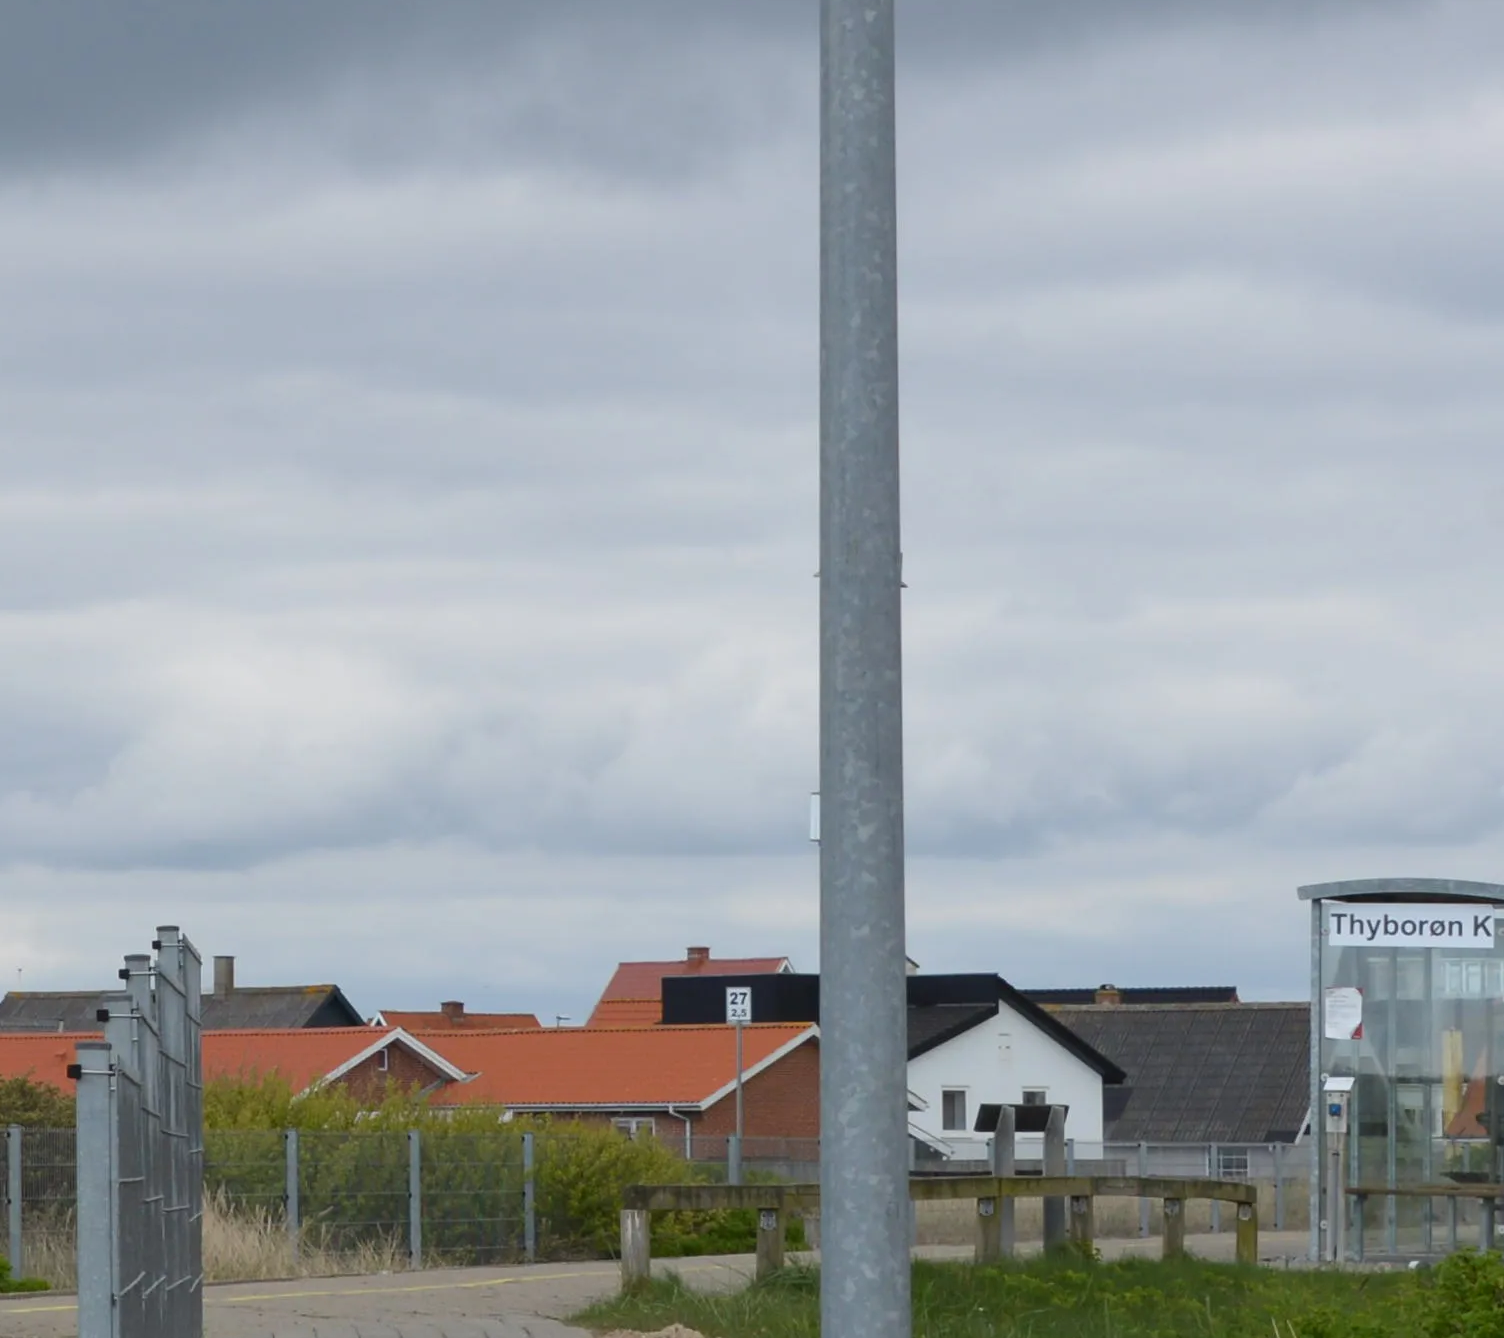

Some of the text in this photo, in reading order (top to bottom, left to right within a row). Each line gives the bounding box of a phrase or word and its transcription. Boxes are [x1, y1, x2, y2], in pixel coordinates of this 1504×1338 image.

[1330, 913, 1492, 941] Thyborøn K
[730, 992, 747, 1005] 27
